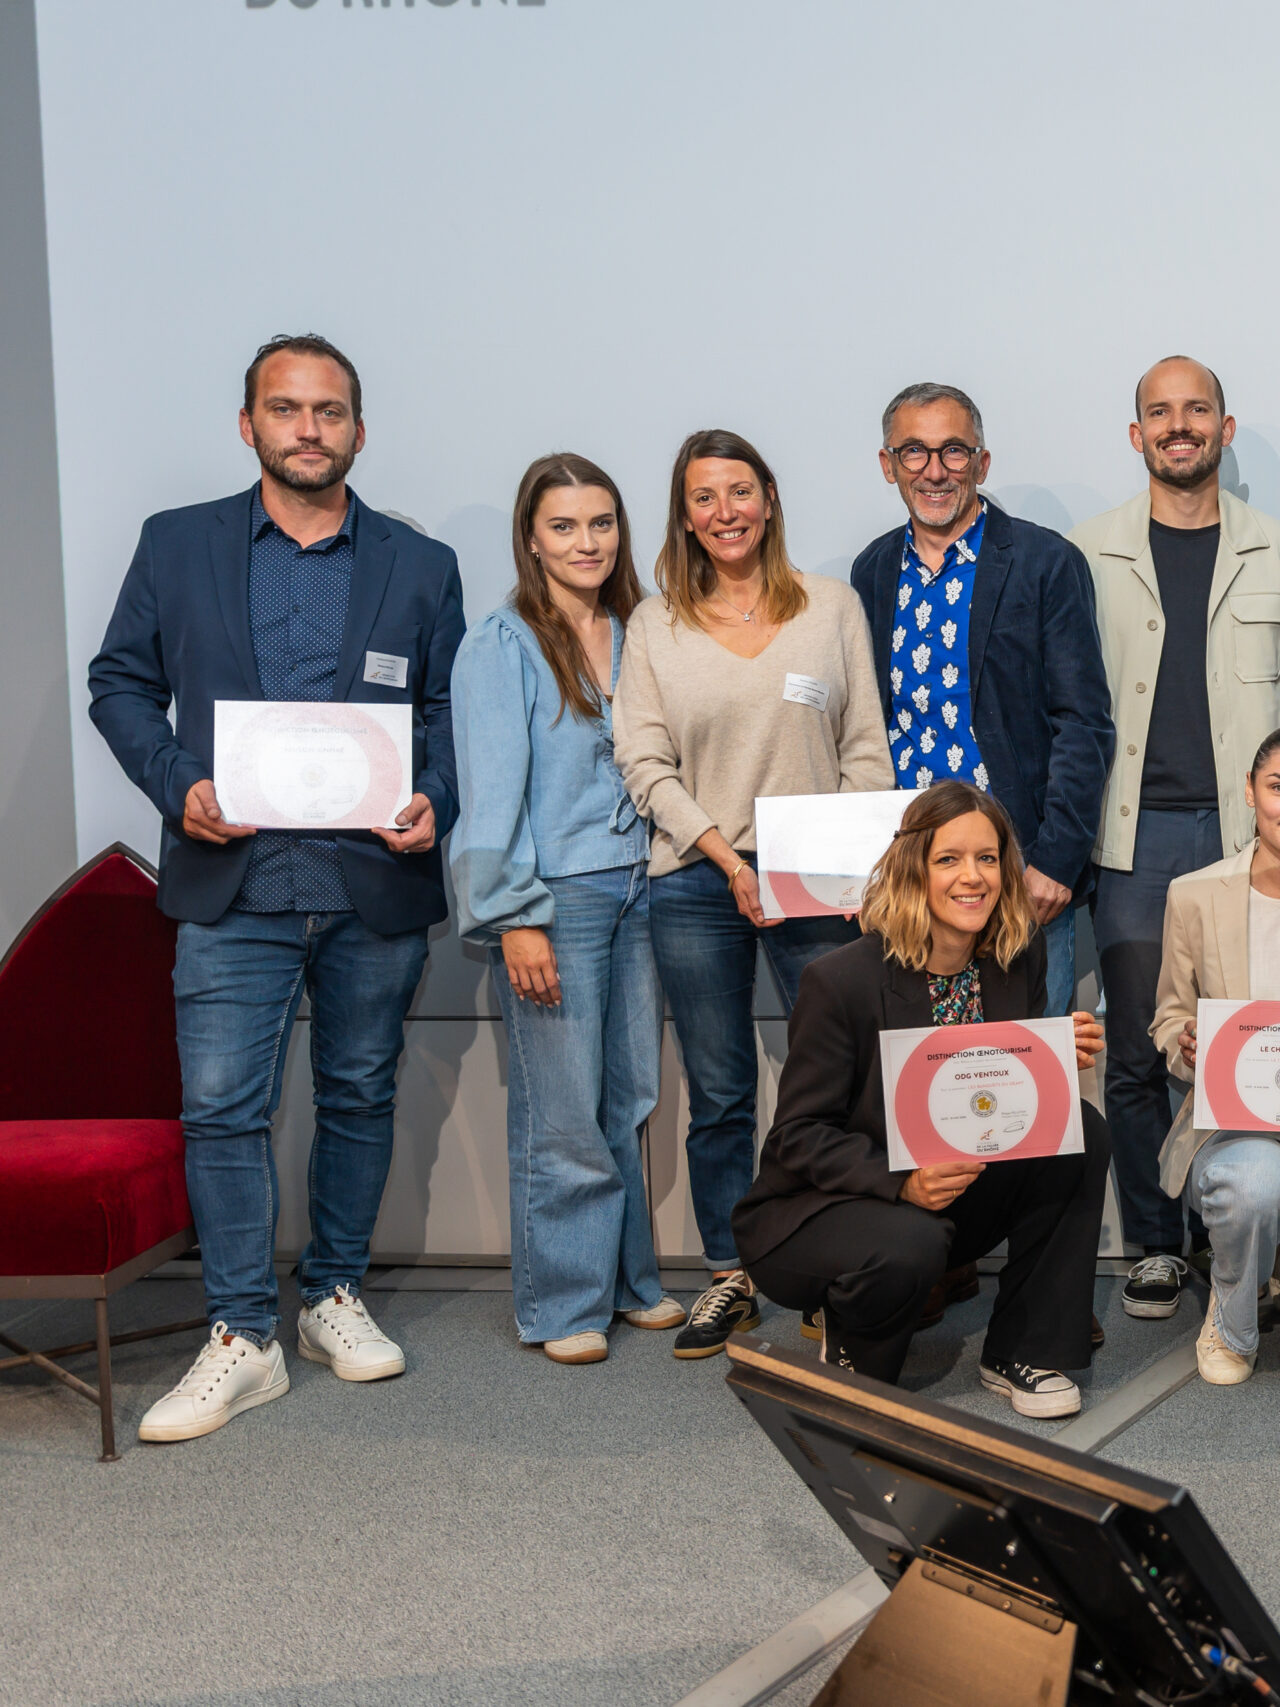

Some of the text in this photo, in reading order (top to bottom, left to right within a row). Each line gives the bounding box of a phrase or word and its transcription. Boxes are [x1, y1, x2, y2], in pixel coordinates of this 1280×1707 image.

[927, 1050, 975, 1061] DISTINCTION
[977, 1046, 1032, 1057] ŒNOTOURISME
[955, 1070, 1009, 1081] ODG VENTOUX
